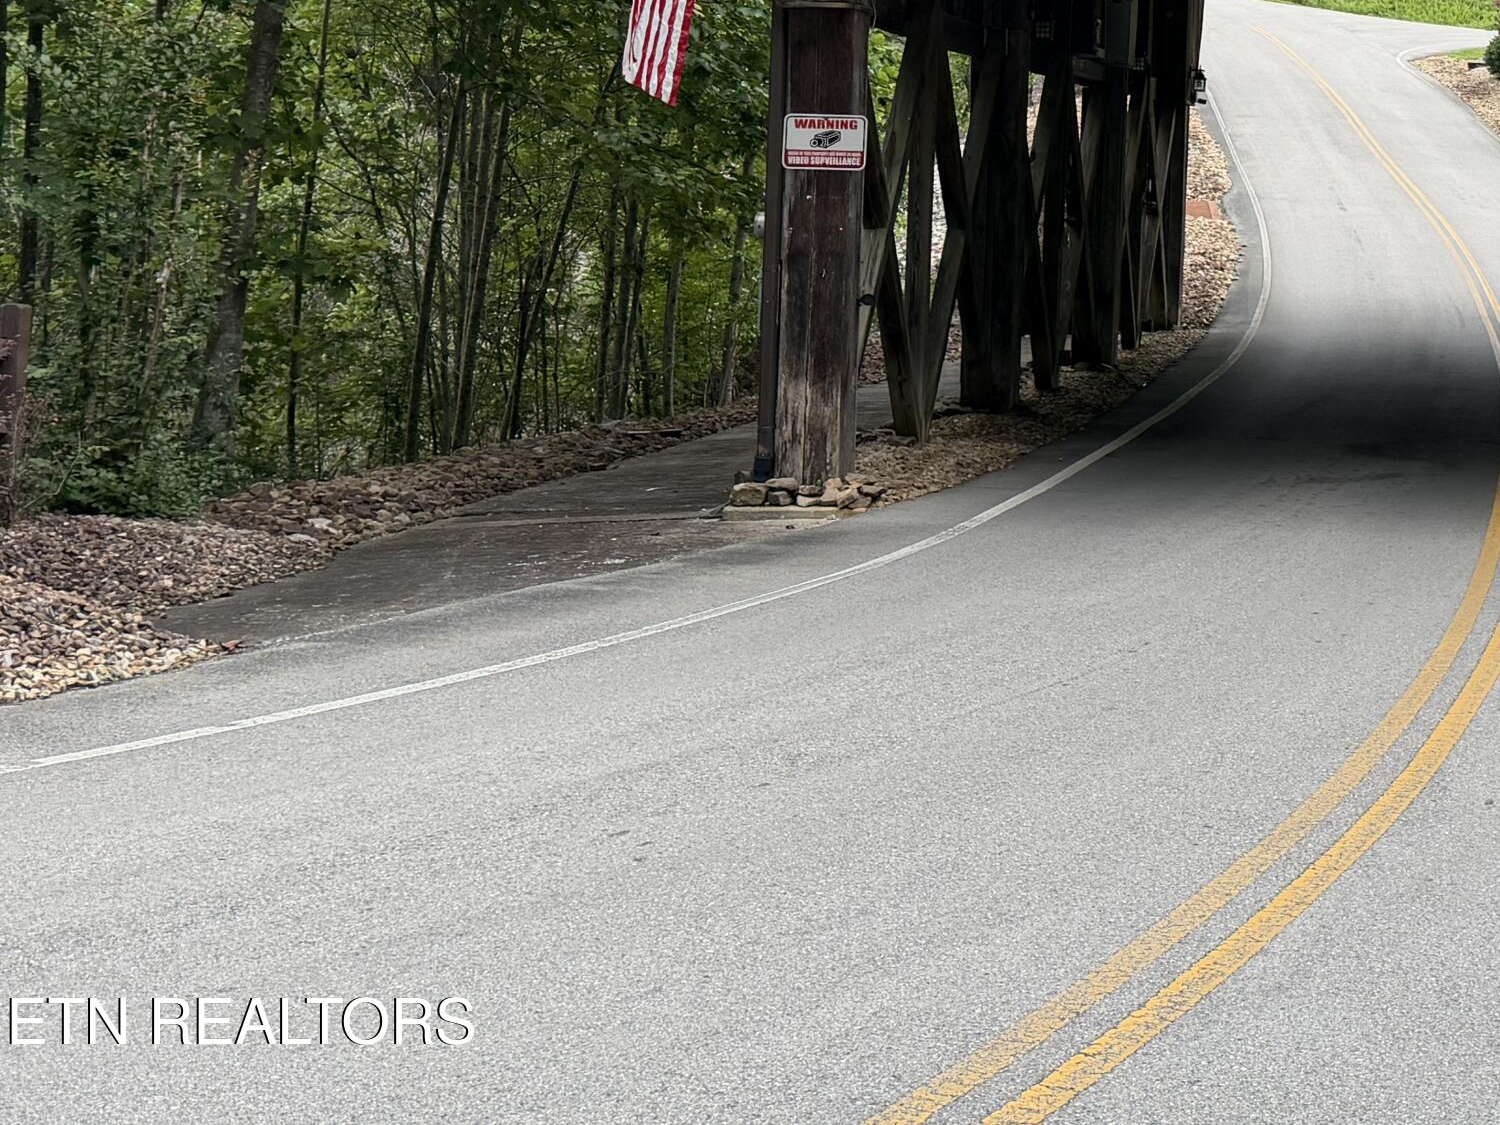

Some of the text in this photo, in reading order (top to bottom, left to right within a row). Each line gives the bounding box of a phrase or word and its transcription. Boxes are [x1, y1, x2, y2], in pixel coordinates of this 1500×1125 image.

[794, 119, 858, 130] WARNING
[787, 155, 861, 166] VIDEO SURVEILLANCE
